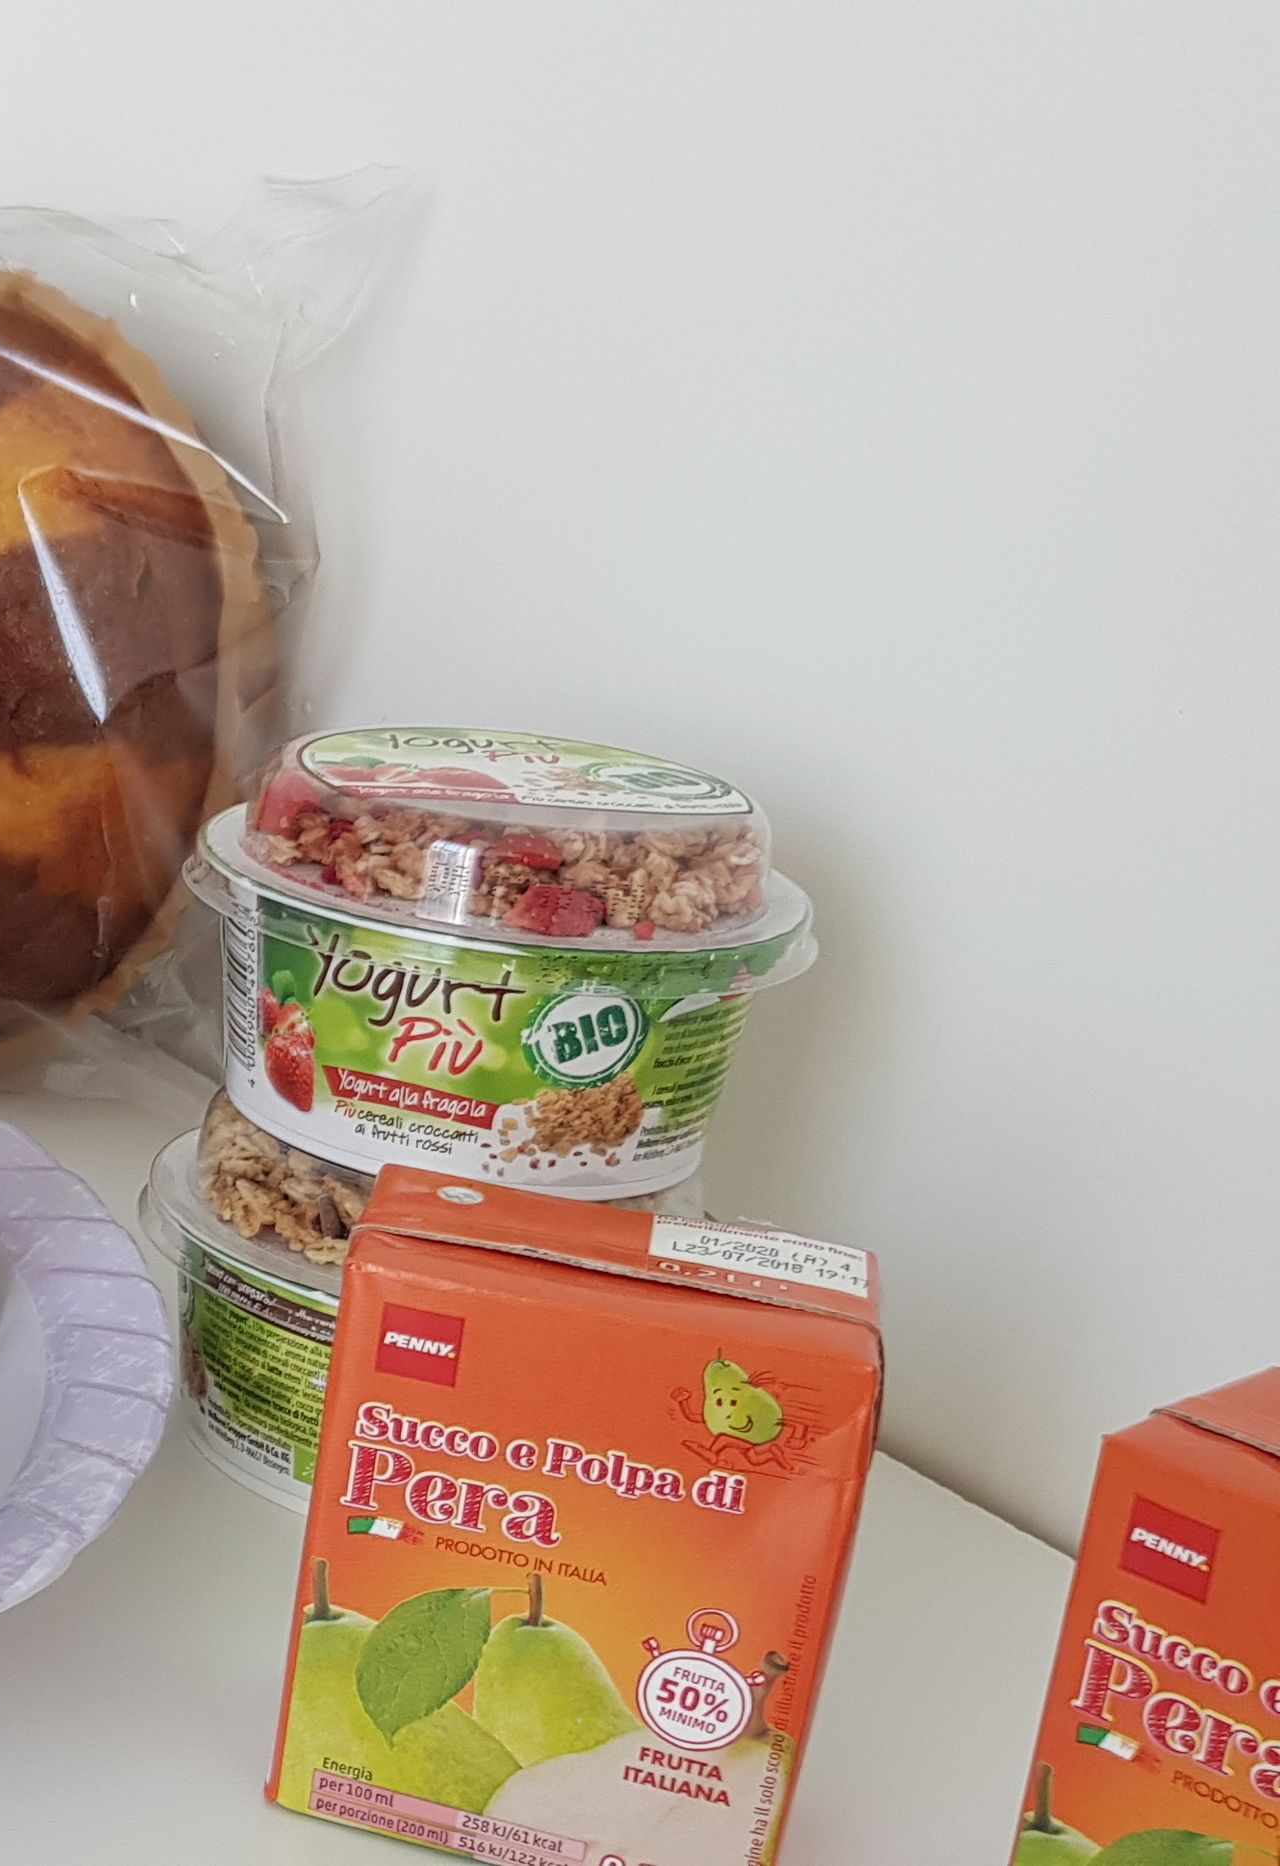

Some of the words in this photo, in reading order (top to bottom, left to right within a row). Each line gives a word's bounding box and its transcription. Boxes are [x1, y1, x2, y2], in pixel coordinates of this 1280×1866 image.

[306, 924, 527, 1027] Yogurt
[387, 1015, 484, 1076] Più
[547, 1003, 630, 1065] BIO
[338, 1067, 387, 1097] Yogurt
[390, 1082, 419, 1109] alla
[421, 1089, 487, 1121] fragola
[333, 1099, 358, 1119] Più
[357, 1107, 404, 1131] cereali
[408, 1119, 480, 1145] croccanti
[353, 1123, 366, 1137] ai
[371, 1124, 410, 1148] frutti
[415, 1137, 453, 1156] rossi
[354, 1400, 500, 1462] Succo
[505, 1438, 539, 1472] e
[542, 1437, 686, 1500] Polpa
[691, 1468, 750, 1516] di
[339, 1439, 563, 1549] Pera
[435, 1535, 529, 1571] PRODOTTO
[533, 1556, 554, 1576] IN
[556, 1561, 608, 1587] ITALIA
[795, 1575, 817, 1636] prodotto
[1093, 1598, 1254, 1697] Succo
[655, 1677, 730, 1724] 50%
[672, 1665, 727, 1695] FRUTTA
[658, 1706, 717, 1735] MINIMO
[321, 1756, 374, 1782] Energia
[639, 1745, 725, 1782] FRUTTA
[766, 1732, 787, 1773] scopo
[622, 1764, 731, 1808] ITALIANA
[757, 1775, 778, 1806] solo
[1171, 1769, 1278, 1830] PRODOTTO
[315, 1796, 338, 1813] per
[338, 1802, 396, 1830] porzione
[395, 1817, 426, 1837] (200
[425, 1826, 450, 1846] ml)
[456, 1836, 487, 1854] 516
[319, 1776, 345, 1793] per
[346, 1783, 373, 1802] 100
[374, 1793, 396, 1808] ml
[460, 1814, 492, 1834] 258
[491, 1820, 533, 1846] kJ/61
[531, 1831, 564, 1854] kcal
[749, 1818, 768, 1838] ha
